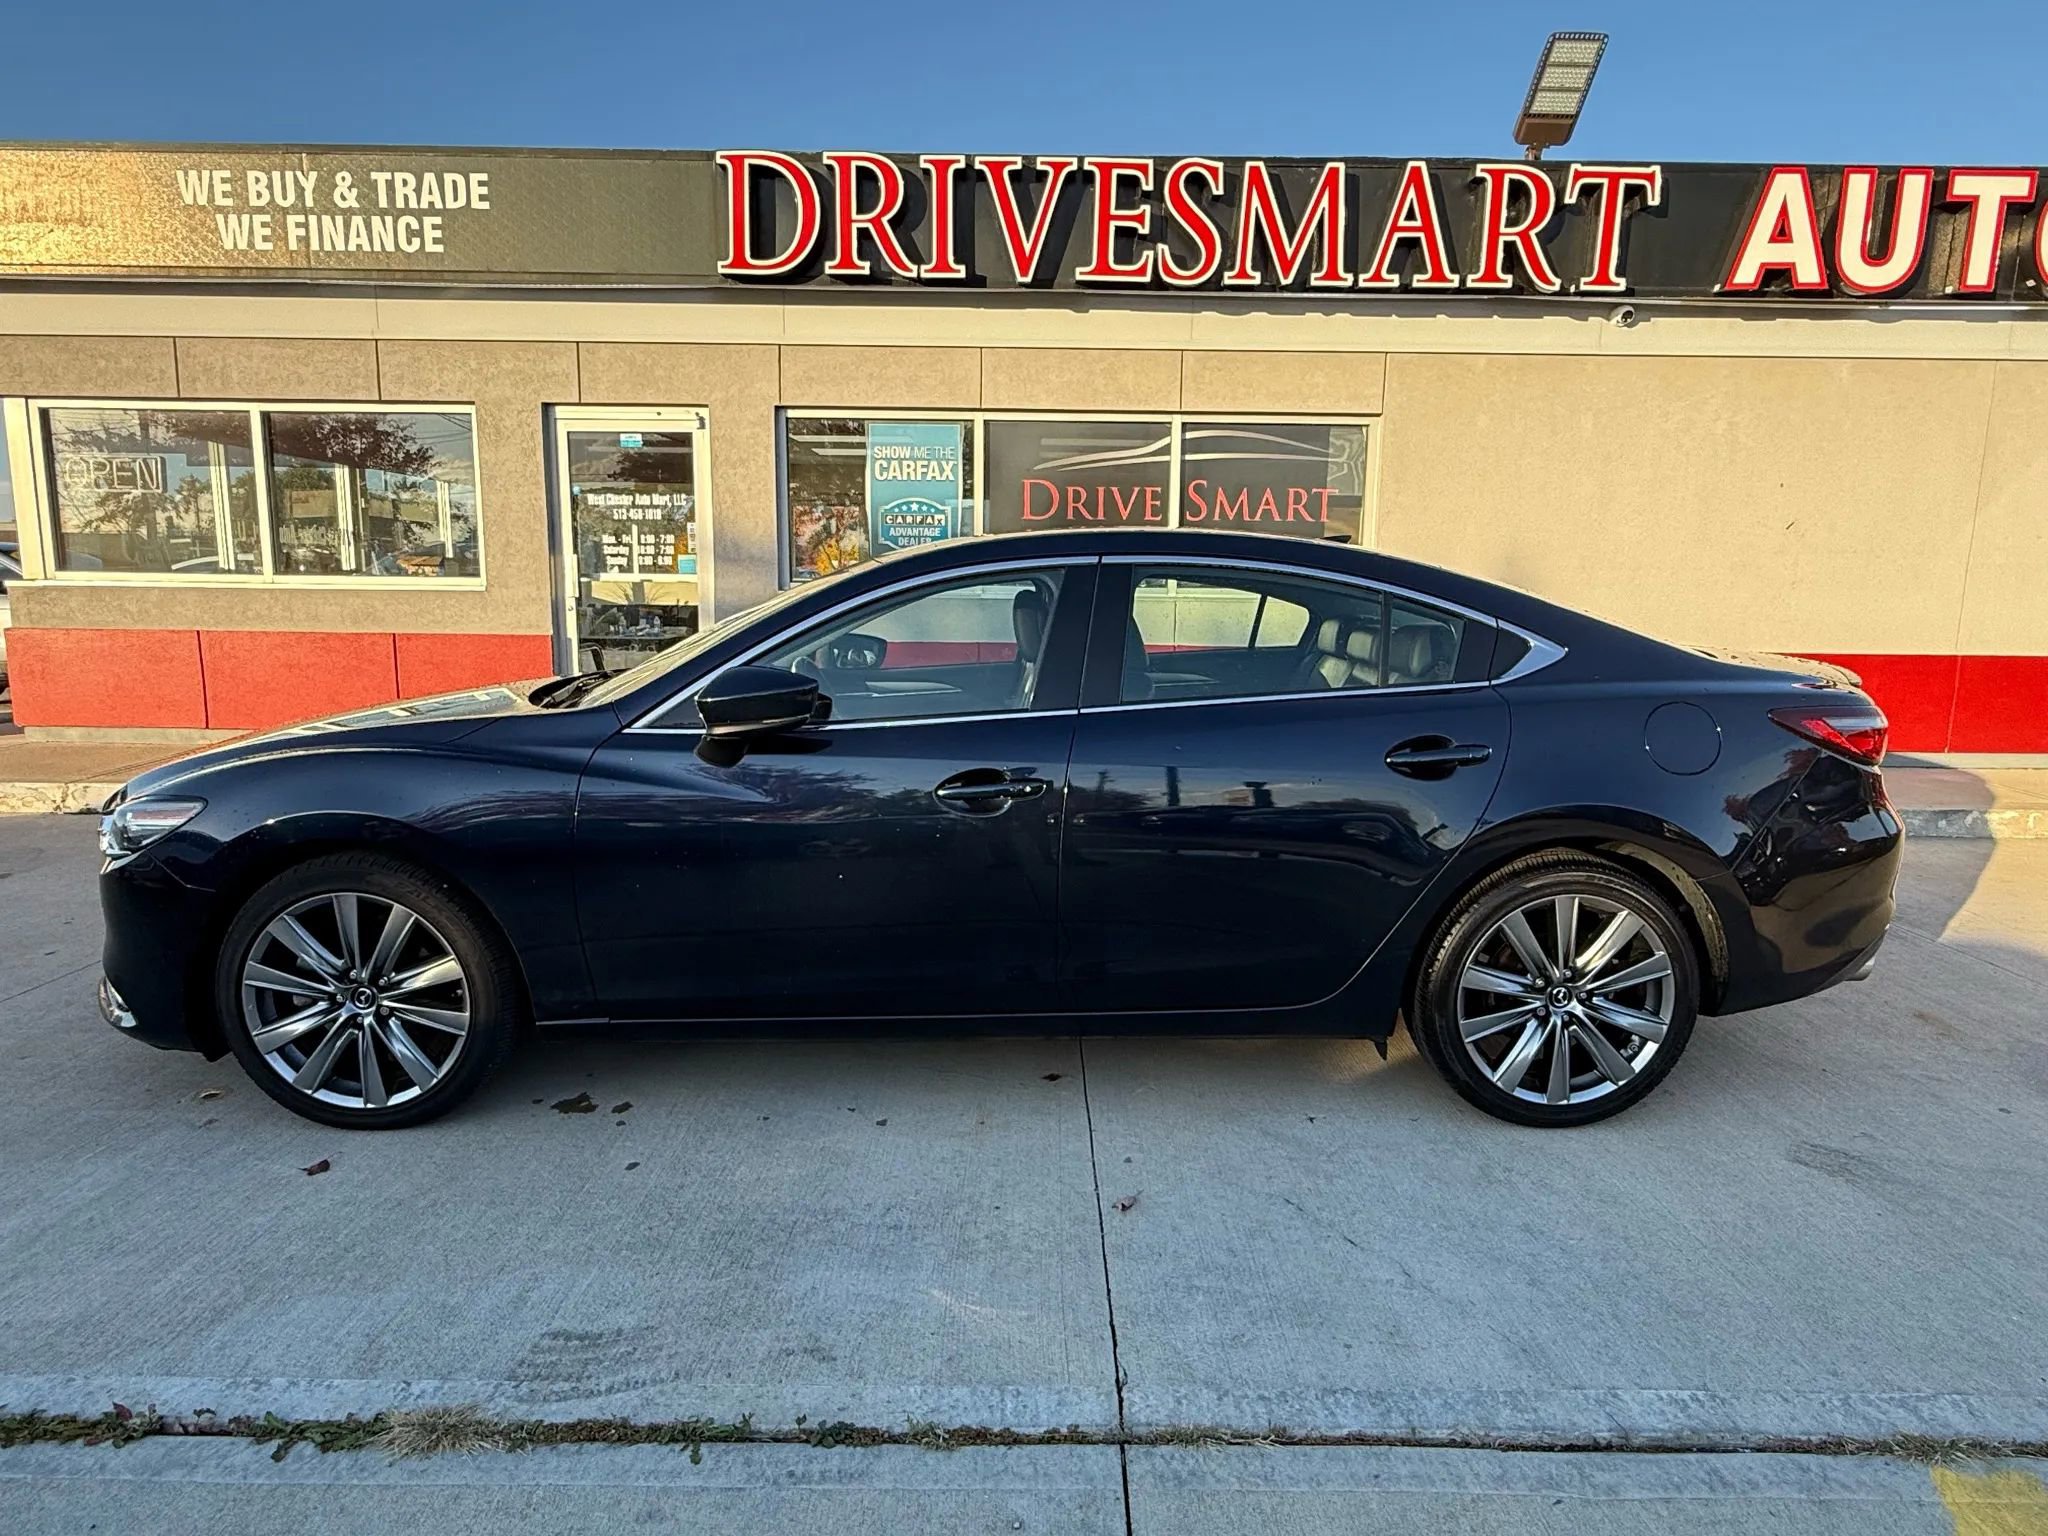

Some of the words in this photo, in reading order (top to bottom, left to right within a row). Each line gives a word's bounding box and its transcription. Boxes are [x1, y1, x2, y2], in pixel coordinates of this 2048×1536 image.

[175, 169, 233, 206] WE
[246, 170, 318, 207] BUY
[332, 171, 360, 208] &
[370, 172, 491, 210] TRADE
[715, 150, 1662, 293] DRIVESMART
[1725, 165, 2048, 294] AUT
[215, 213, 274, 250] WE
[286, 214, 444, 253] FINANCE
[873, 446, 911, 459] SHOW
[914, 446, 932, 459] ME
[934, 446, 956, 459] THE
[65, 457, 158, 490] OPEN
[874, 460, 956, 481] CARFAX
[587, 493, 605, 505] West
[606, 493, 633, 505] Chester
[635, 493, 651, 505] Auto
[673, 493, 687, 506] LLC
[885, 514, 945, 526] CARFAX
[888, 527, 942, 537] ADVANTAGE
[898, 537, 932, 546] DEALER
[603, 545, 629, 556] Saturday
[606, 555, 628, 567] Sunday
